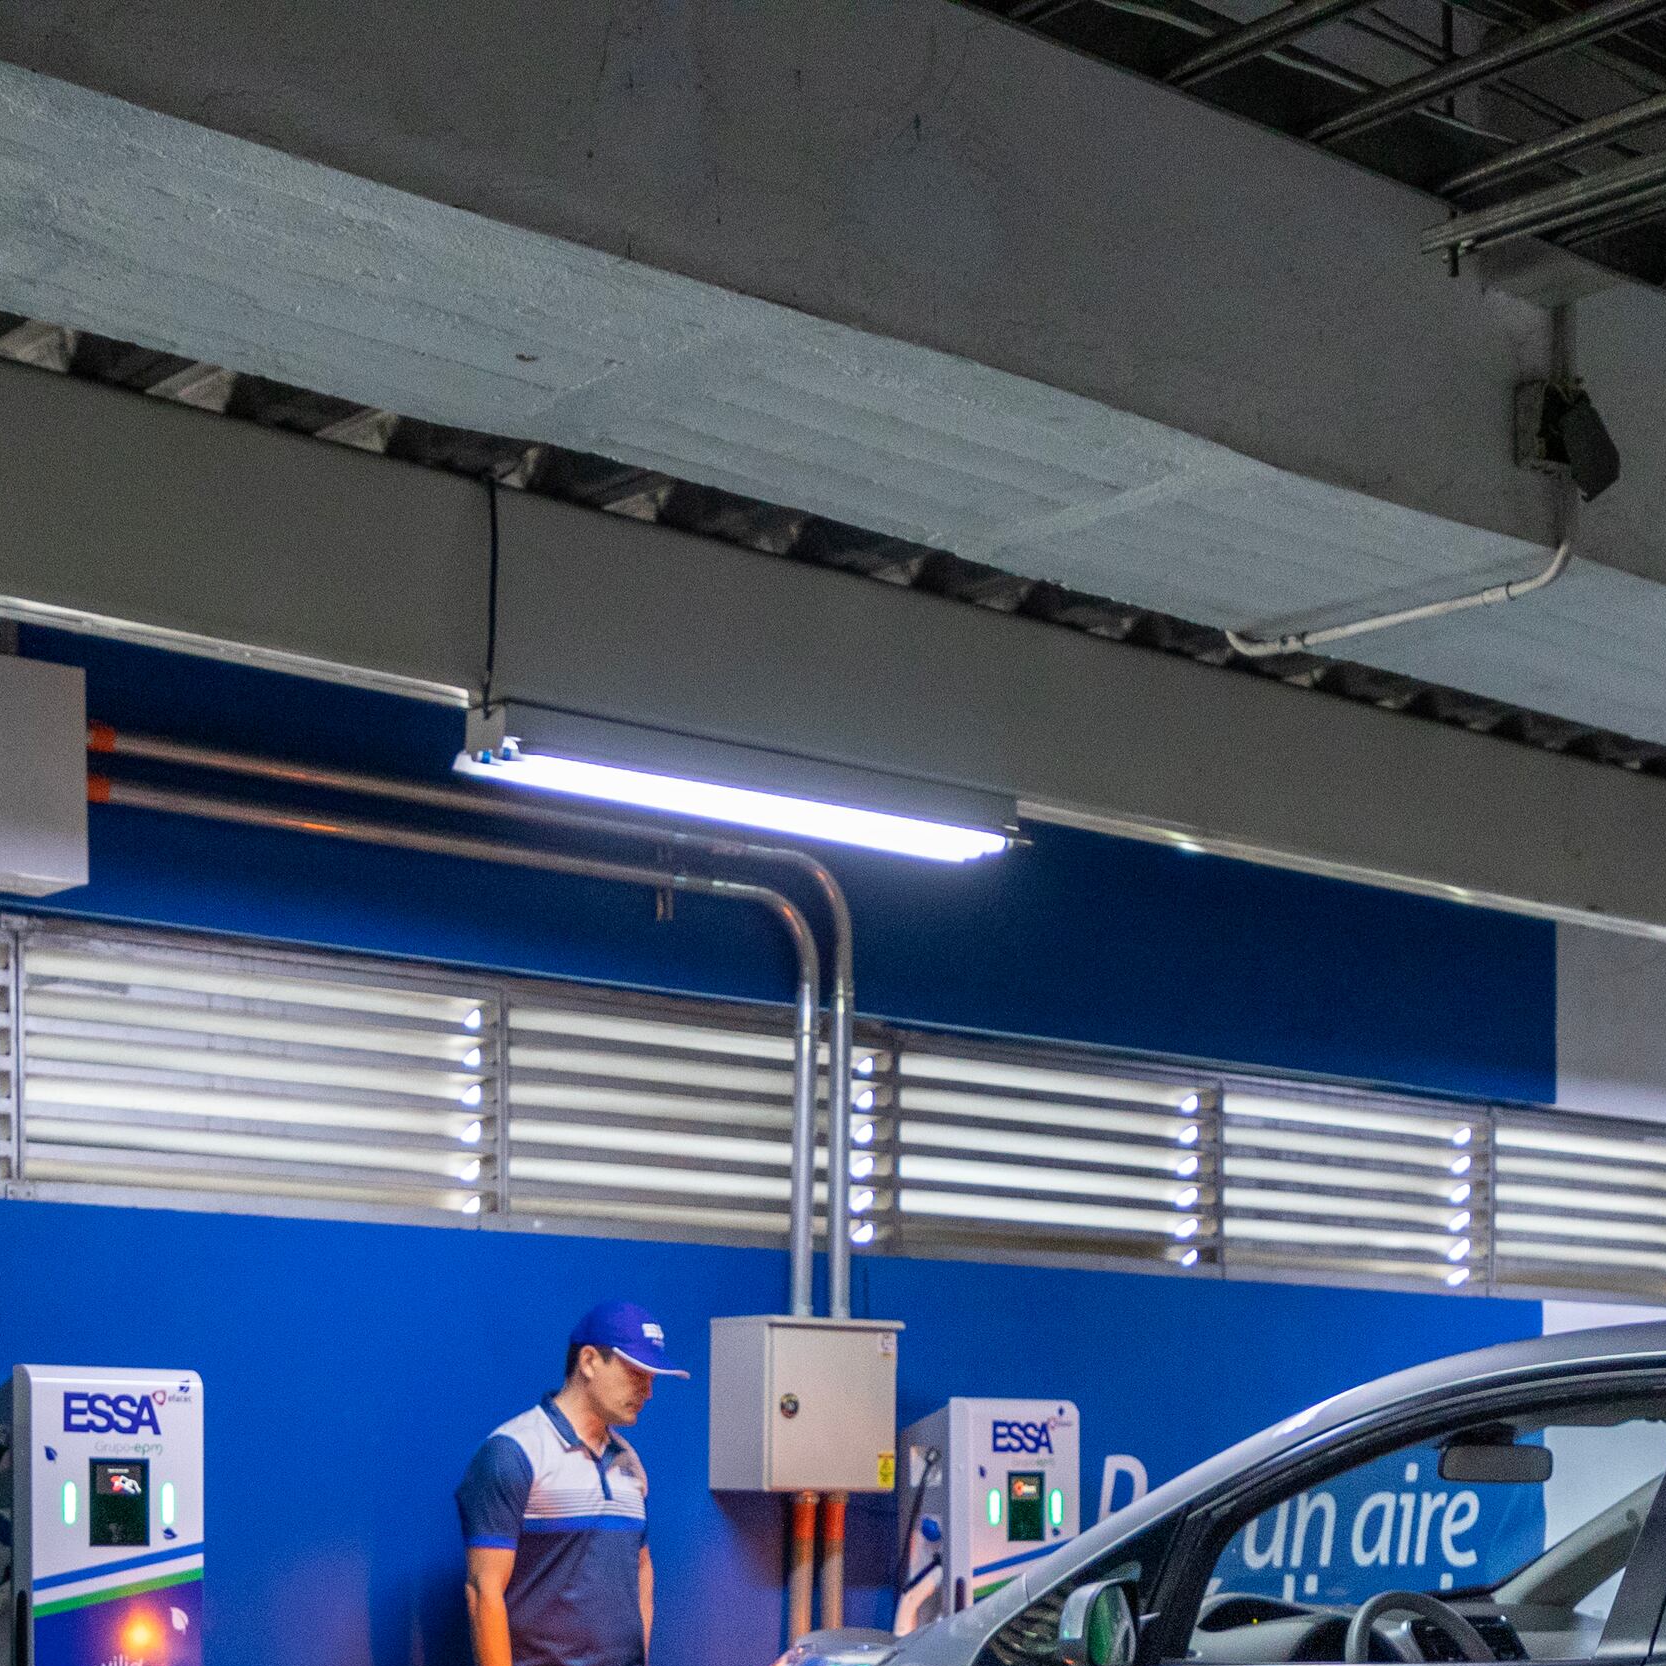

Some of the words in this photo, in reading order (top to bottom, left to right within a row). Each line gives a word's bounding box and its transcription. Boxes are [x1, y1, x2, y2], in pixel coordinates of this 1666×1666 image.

[63, 1391, 161, 1435] ESSA
[991, 1420, 1054, 1454] ESSA
[1242, 1490, 1337, 1570] un
[1350, 1463, 1479, 1569] aire
